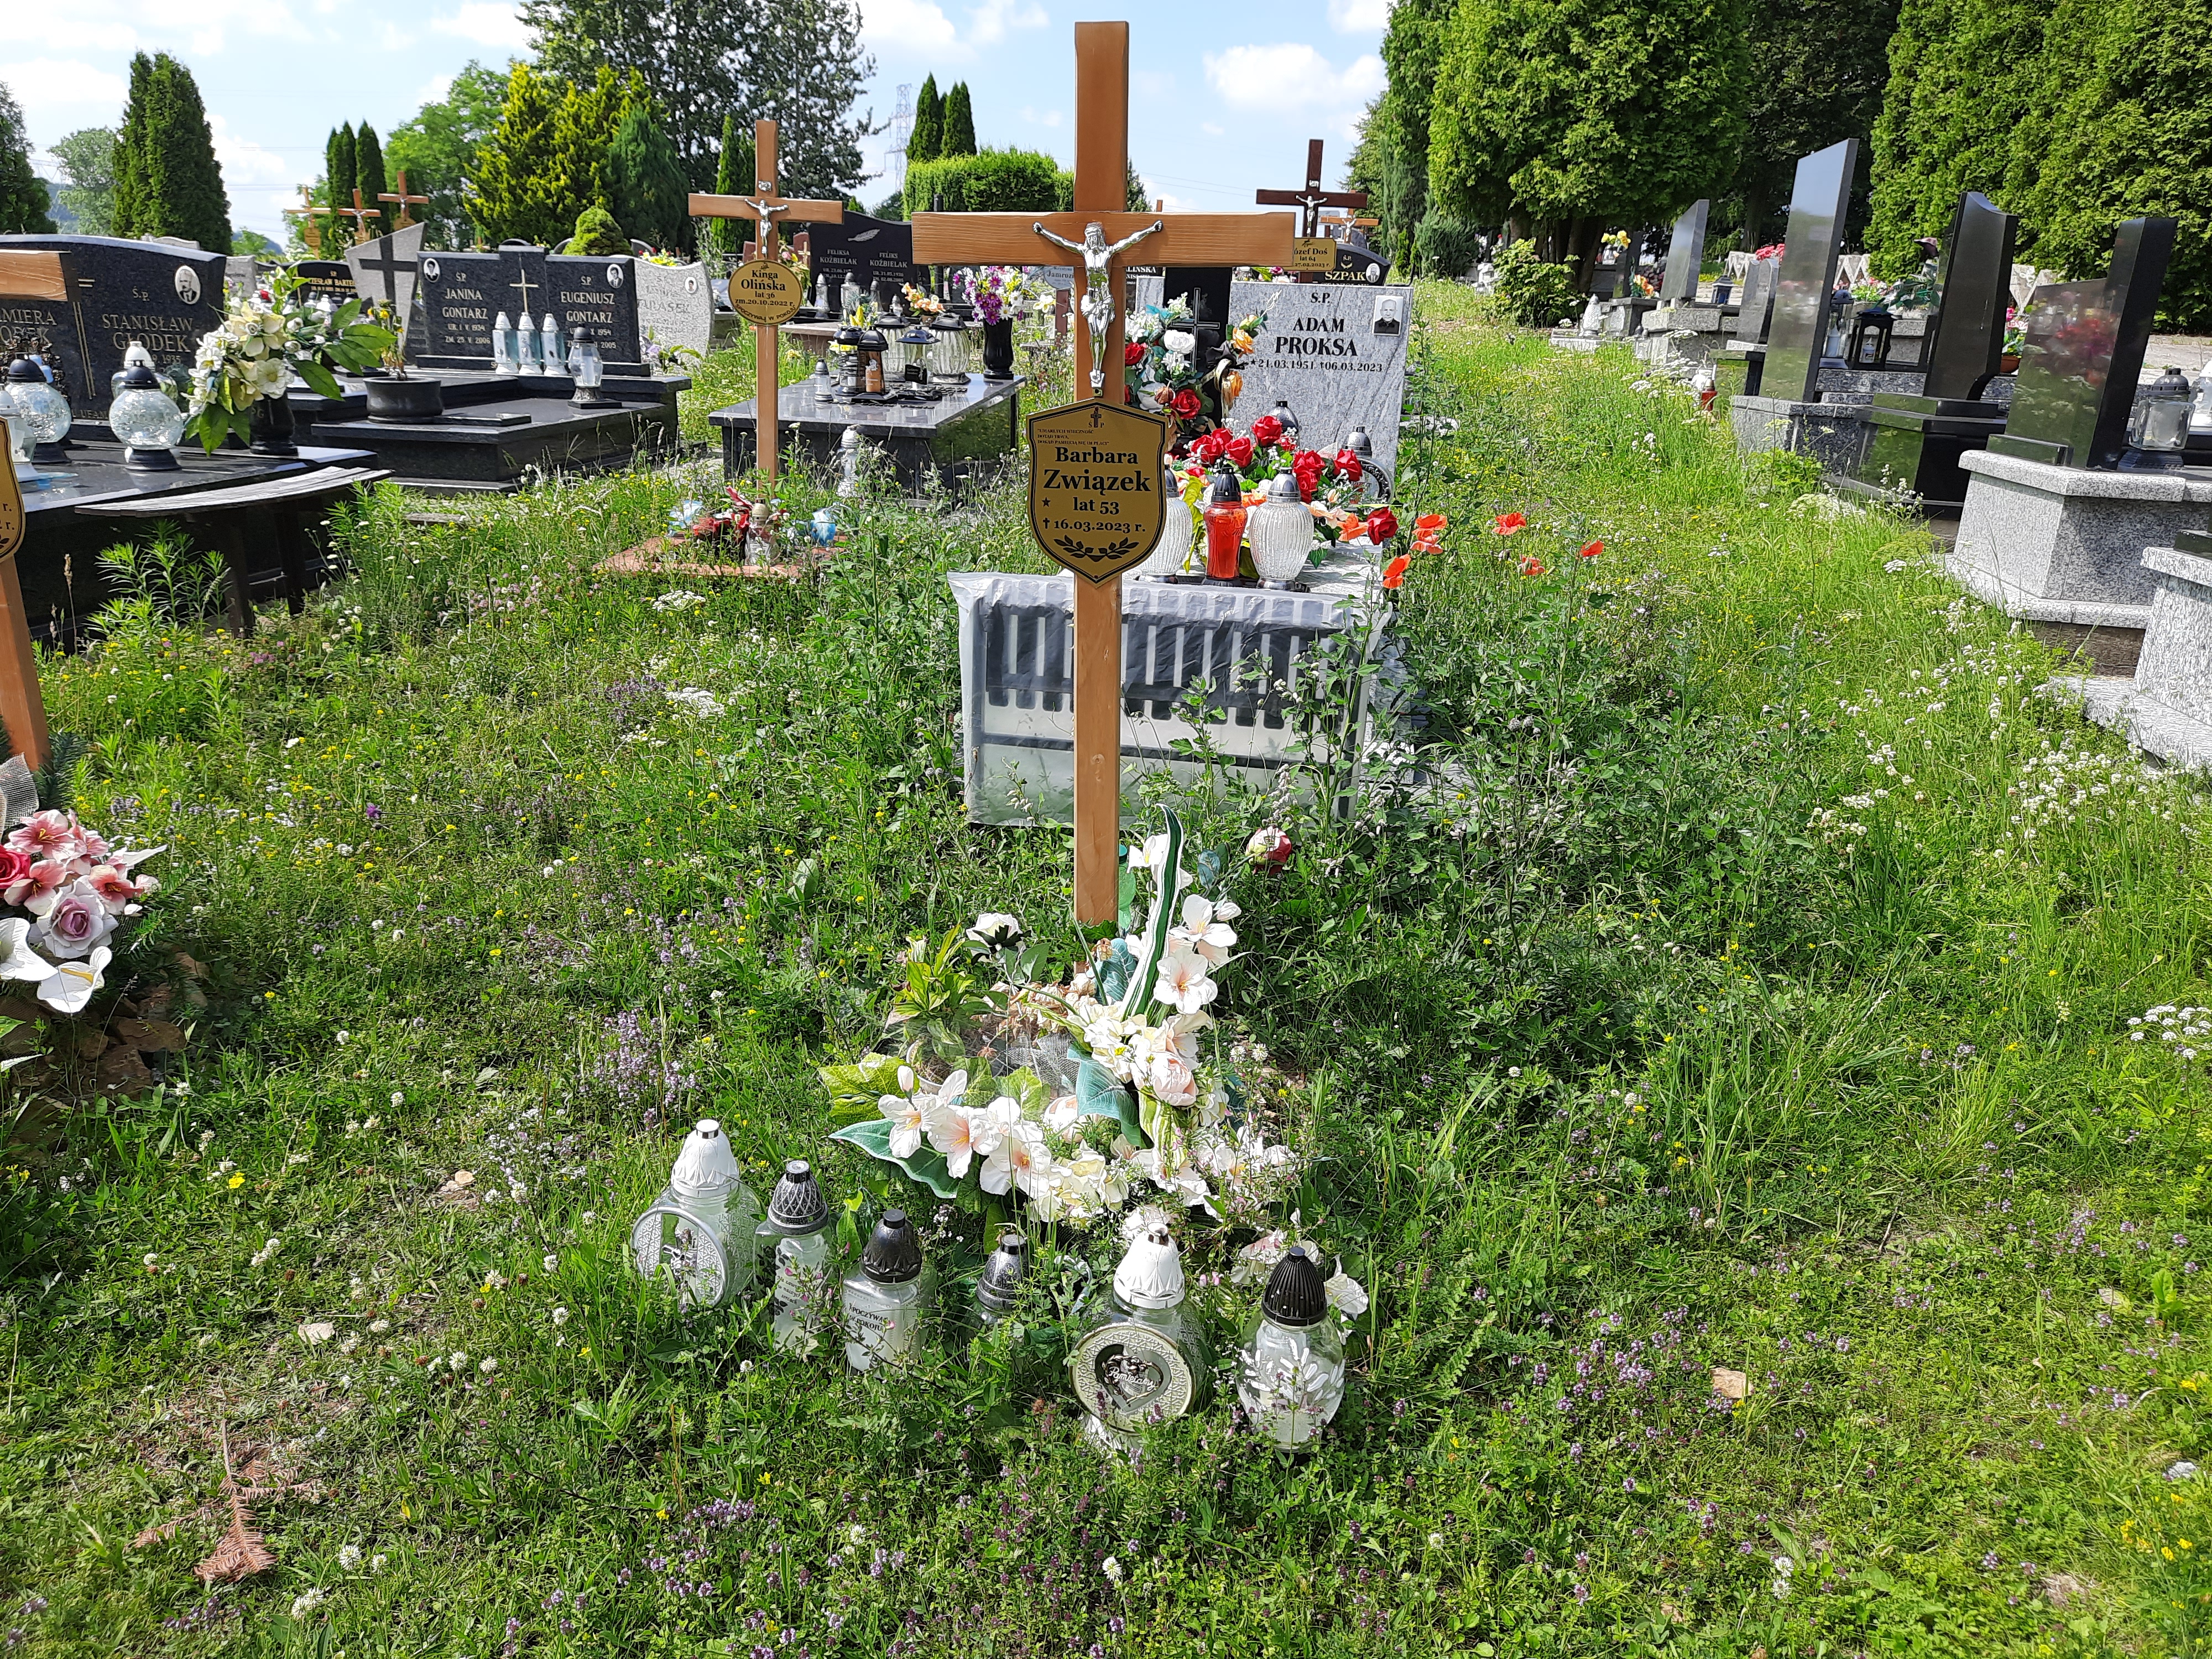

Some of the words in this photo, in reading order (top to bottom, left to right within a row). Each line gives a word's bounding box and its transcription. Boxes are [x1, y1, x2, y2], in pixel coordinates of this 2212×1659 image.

[752, 269, 779, 280] Kinga
[1324, 272, 1366, 281] SZPAK
[741, 279, 786, 291] Olińska
[445, 288, 483, 300] JANINA
[561, 291, 615, 304] EUGENIUSZ
[0, 307, 58, 326] MIERA
[442, 306, 488, 320] GONTARZ
[566, 310, 613, 324] GONTARZ
[735, 304, 766, 322] SPOCZYWAJ
[776, 306, 796, 320] POKOJU
[102, 313, 193, 332] STANISŁAW
[1293, 317, 1344, 332] ADAM
[1275, 336, 1358, 357] PROKSA
[1055, 447, 1139, 465] Barbara
[1043, 469, 1151, 496] Związek
[1073, 497, 1096, 512] lat
[1099, 502, 1120, 515] 53
[1053, 519, 1131, 534] 16.03.2023
[1135, 523, 1146, 533] r.
